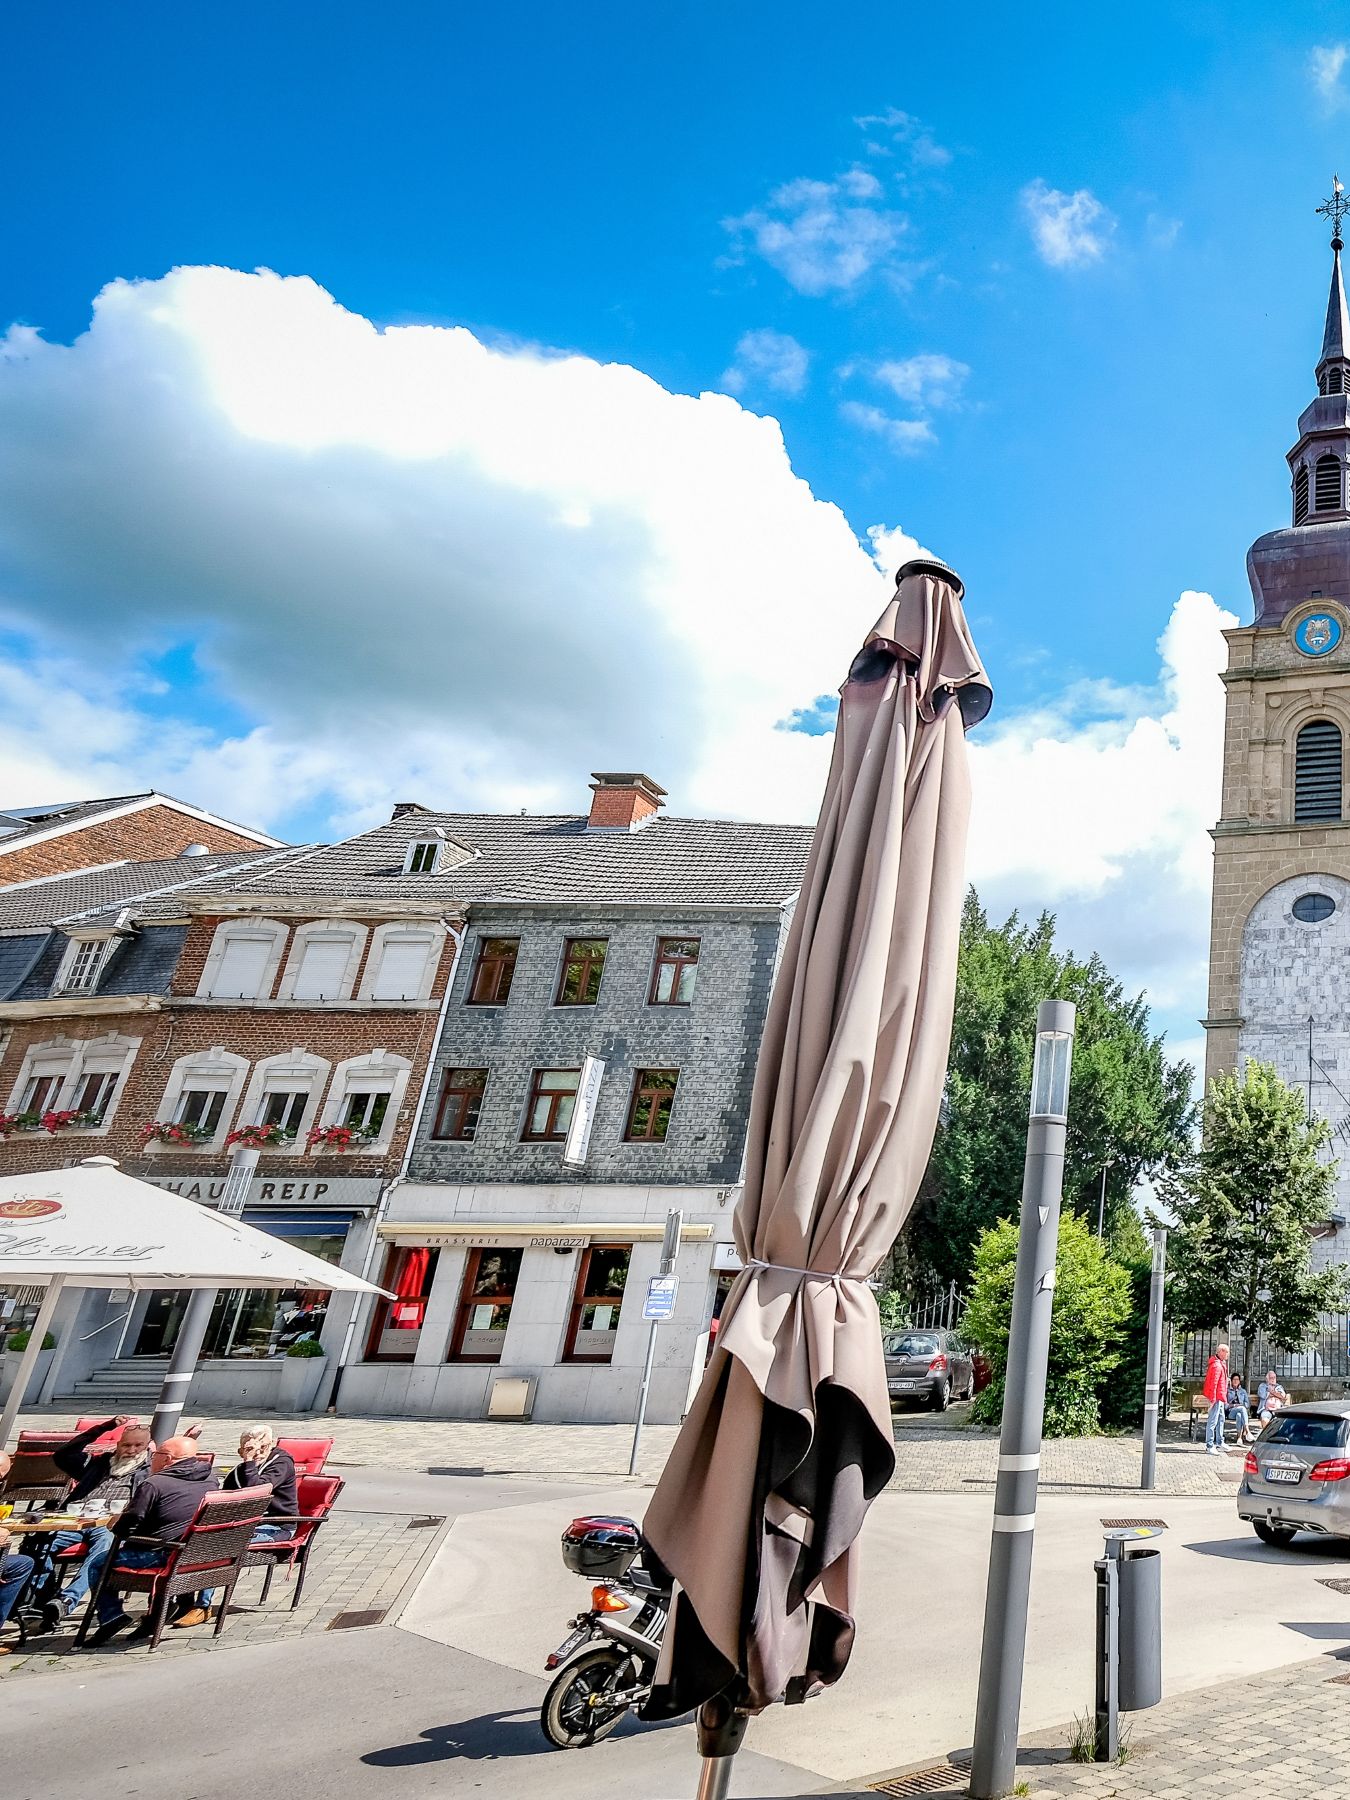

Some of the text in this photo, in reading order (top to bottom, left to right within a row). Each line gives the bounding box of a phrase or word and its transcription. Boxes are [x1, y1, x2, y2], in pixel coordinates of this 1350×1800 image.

[260, 1183, 329, 1200] REIP
[426, 1235, 586, 1247] BRASSERIE paparazzi
